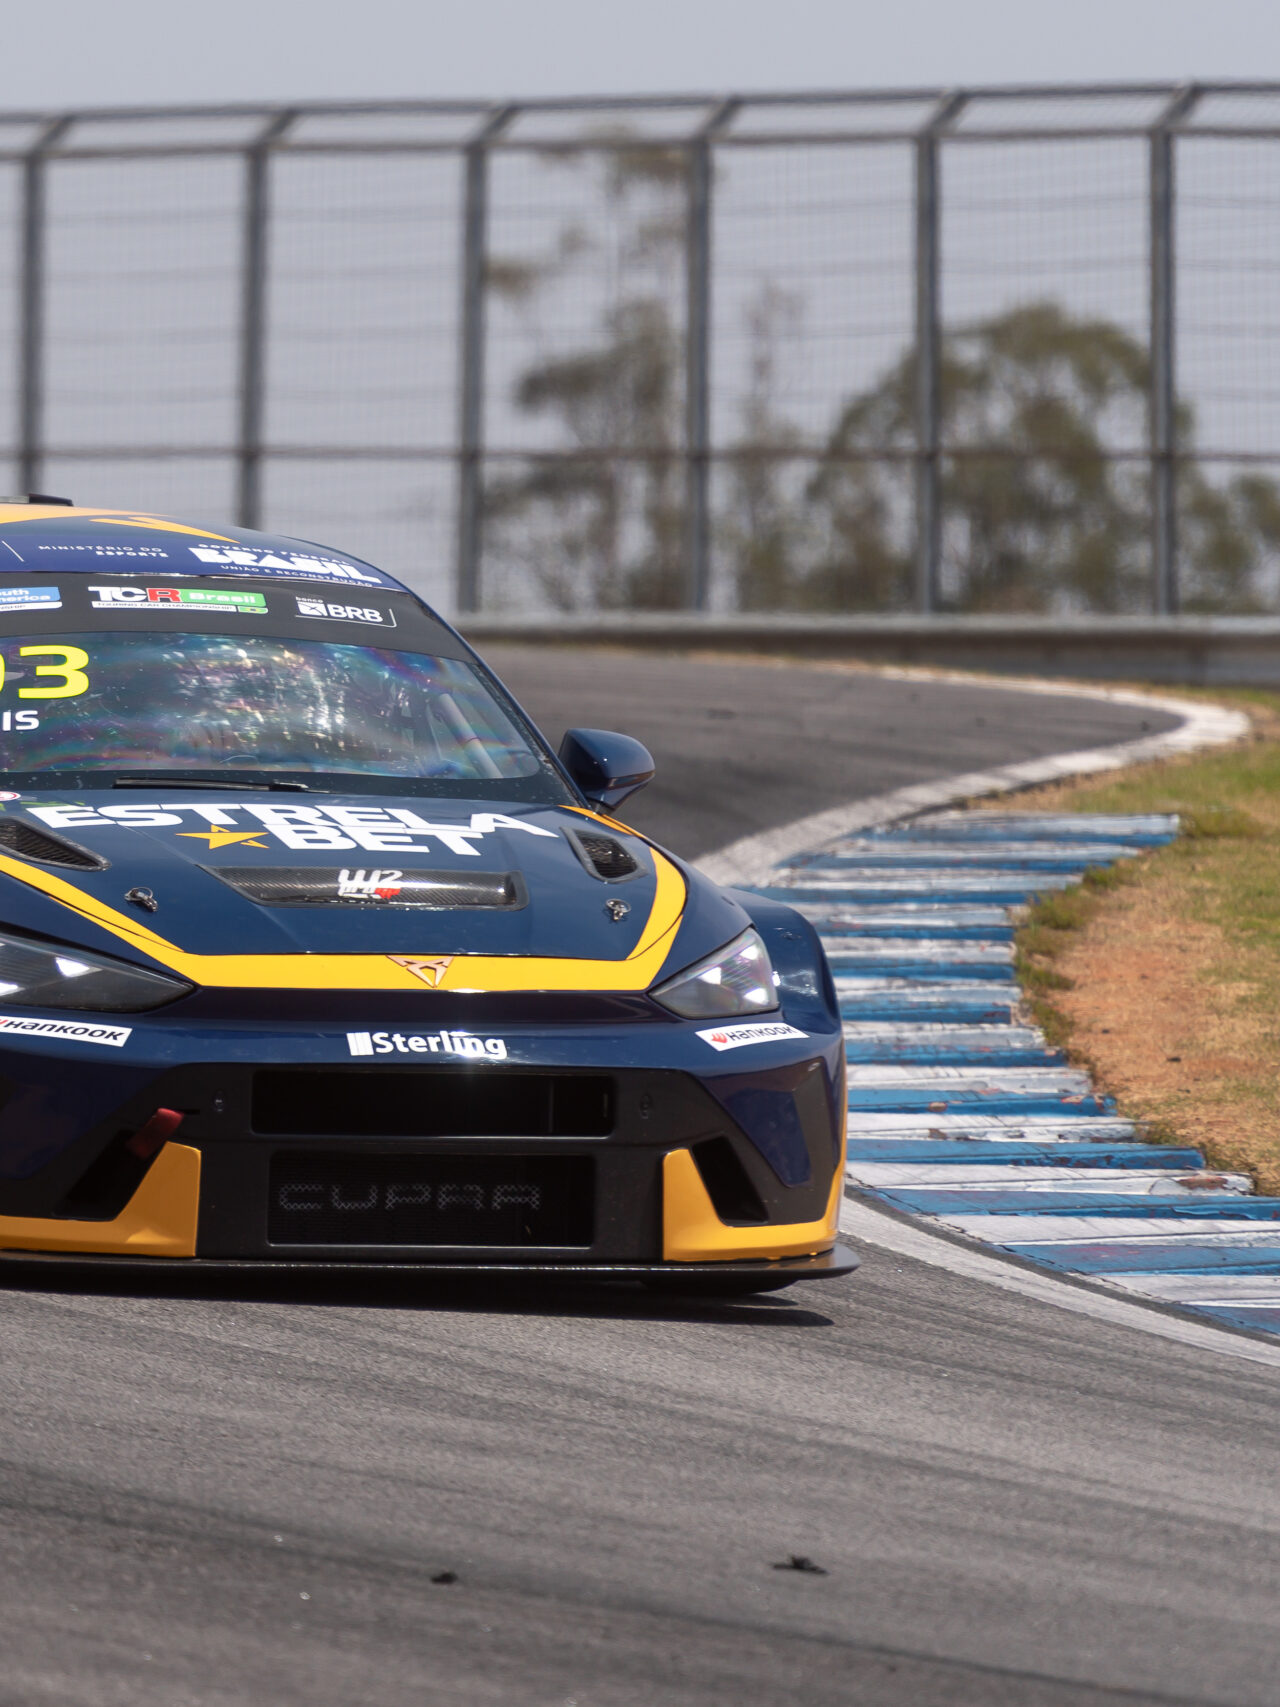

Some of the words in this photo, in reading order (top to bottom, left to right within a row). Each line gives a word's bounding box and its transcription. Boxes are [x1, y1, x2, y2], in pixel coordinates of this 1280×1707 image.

[188, 547, 383, 584] BRASIL
[198, 543, 275, 554] GOVERNO
[280, 550, 352, 566] FEDERAL
[220, 565, 260, 573] UNIÃO
[88, 586, 182, 602] TCR
[188, 592, 256, 604] Brasil
[295, 596, 324, 604] banco
[327, 603, 384, 623] BRB
[26, 803, 559, 838] ESTRELA
[263, 823, 482, 856] BET
[372, 1030, 508, 1060] Sterling
[279, 1184, 541, 1210] CUPRA
